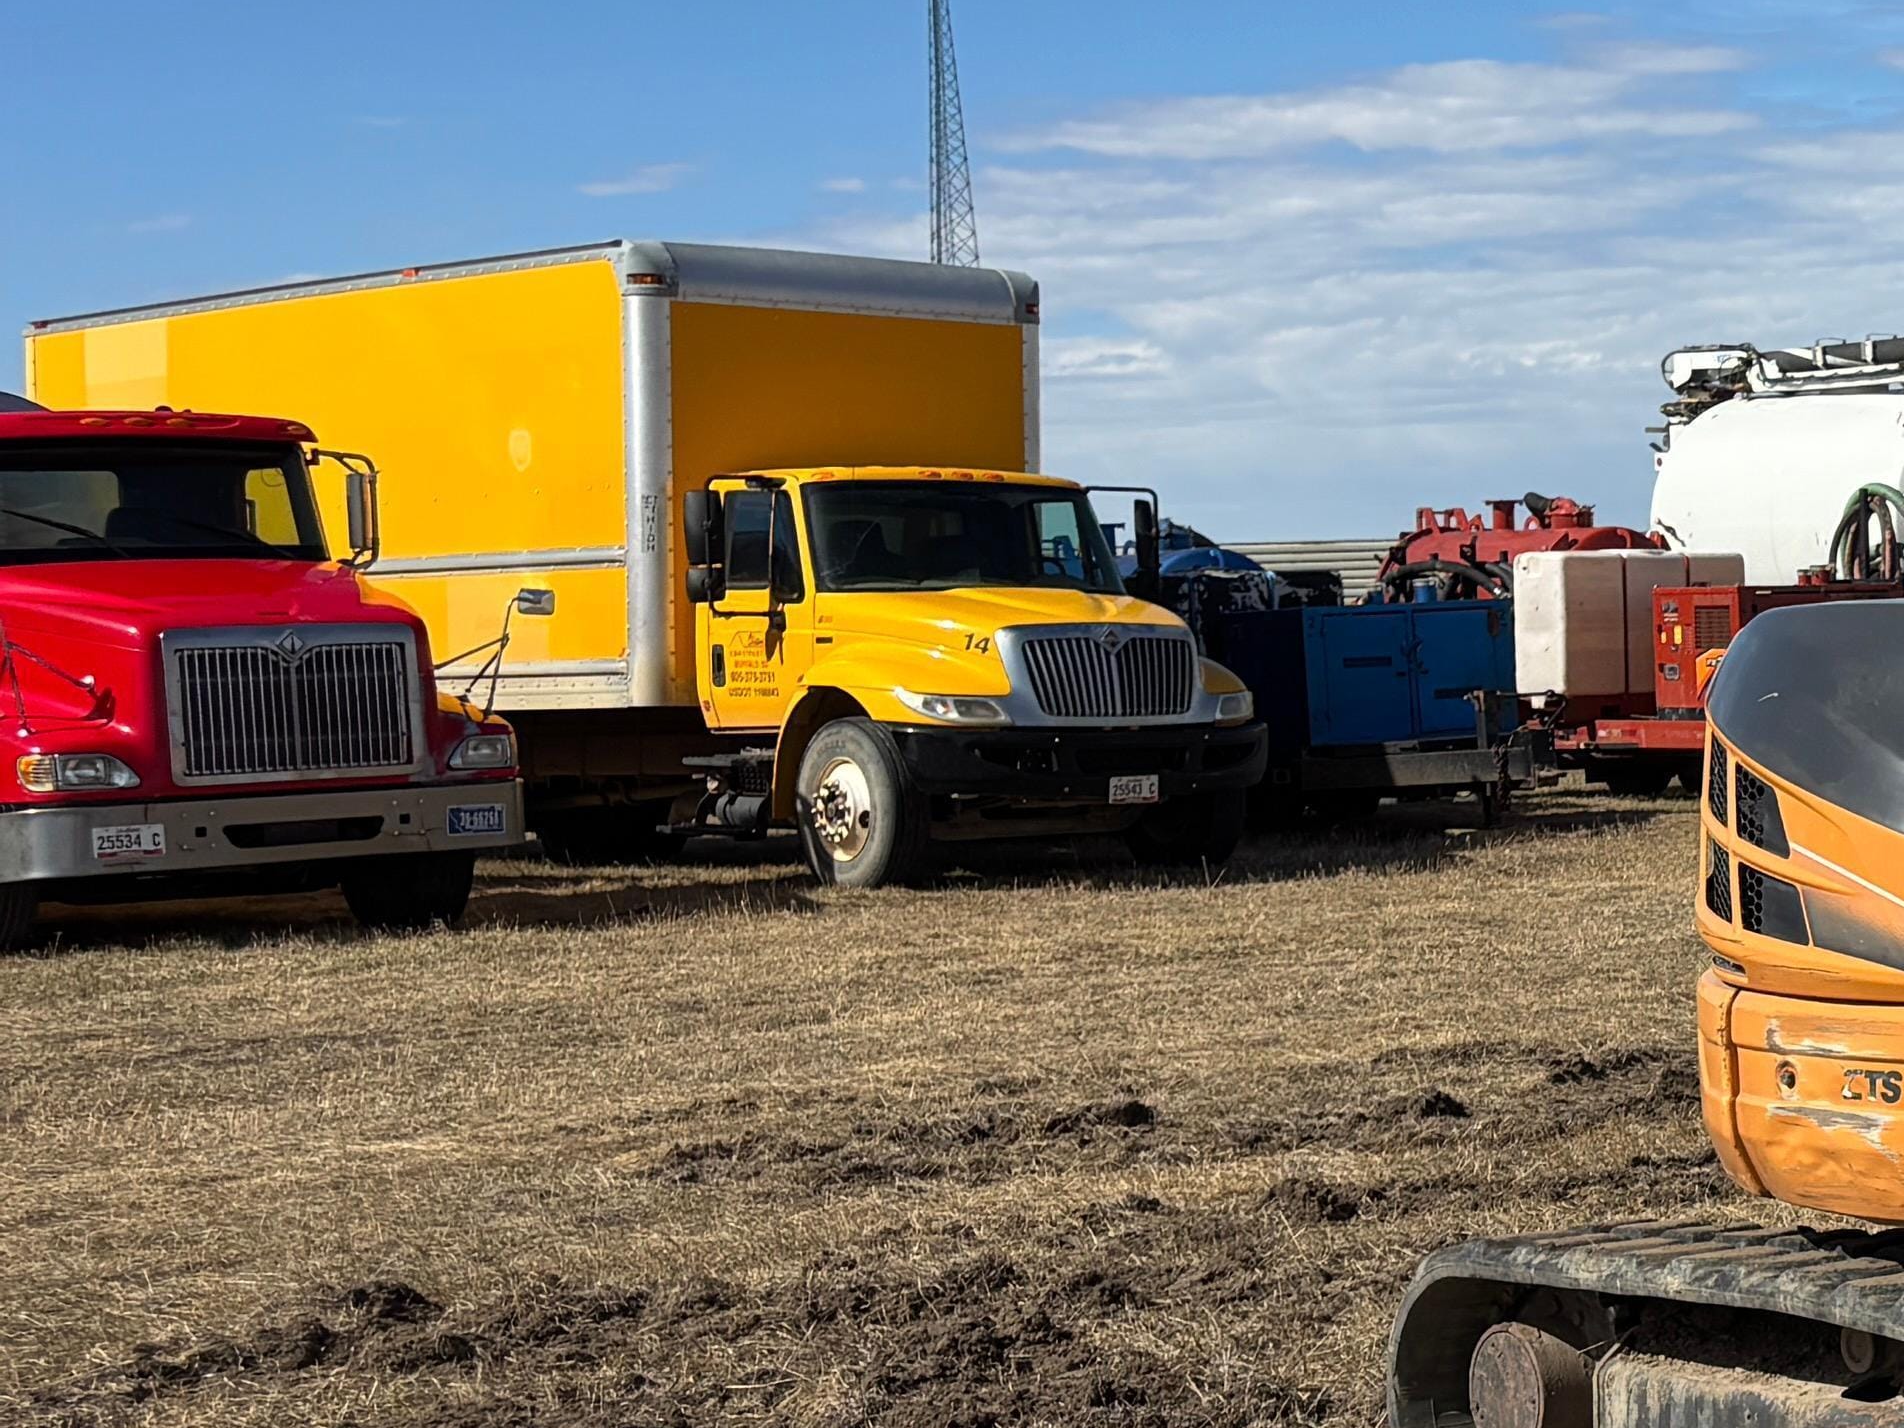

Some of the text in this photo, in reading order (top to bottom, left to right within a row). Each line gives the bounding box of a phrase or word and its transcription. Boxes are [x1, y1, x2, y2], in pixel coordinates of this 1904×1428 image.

[964, 632, 990, 654] 14
[97, 832, 161, 851] 25534 C
